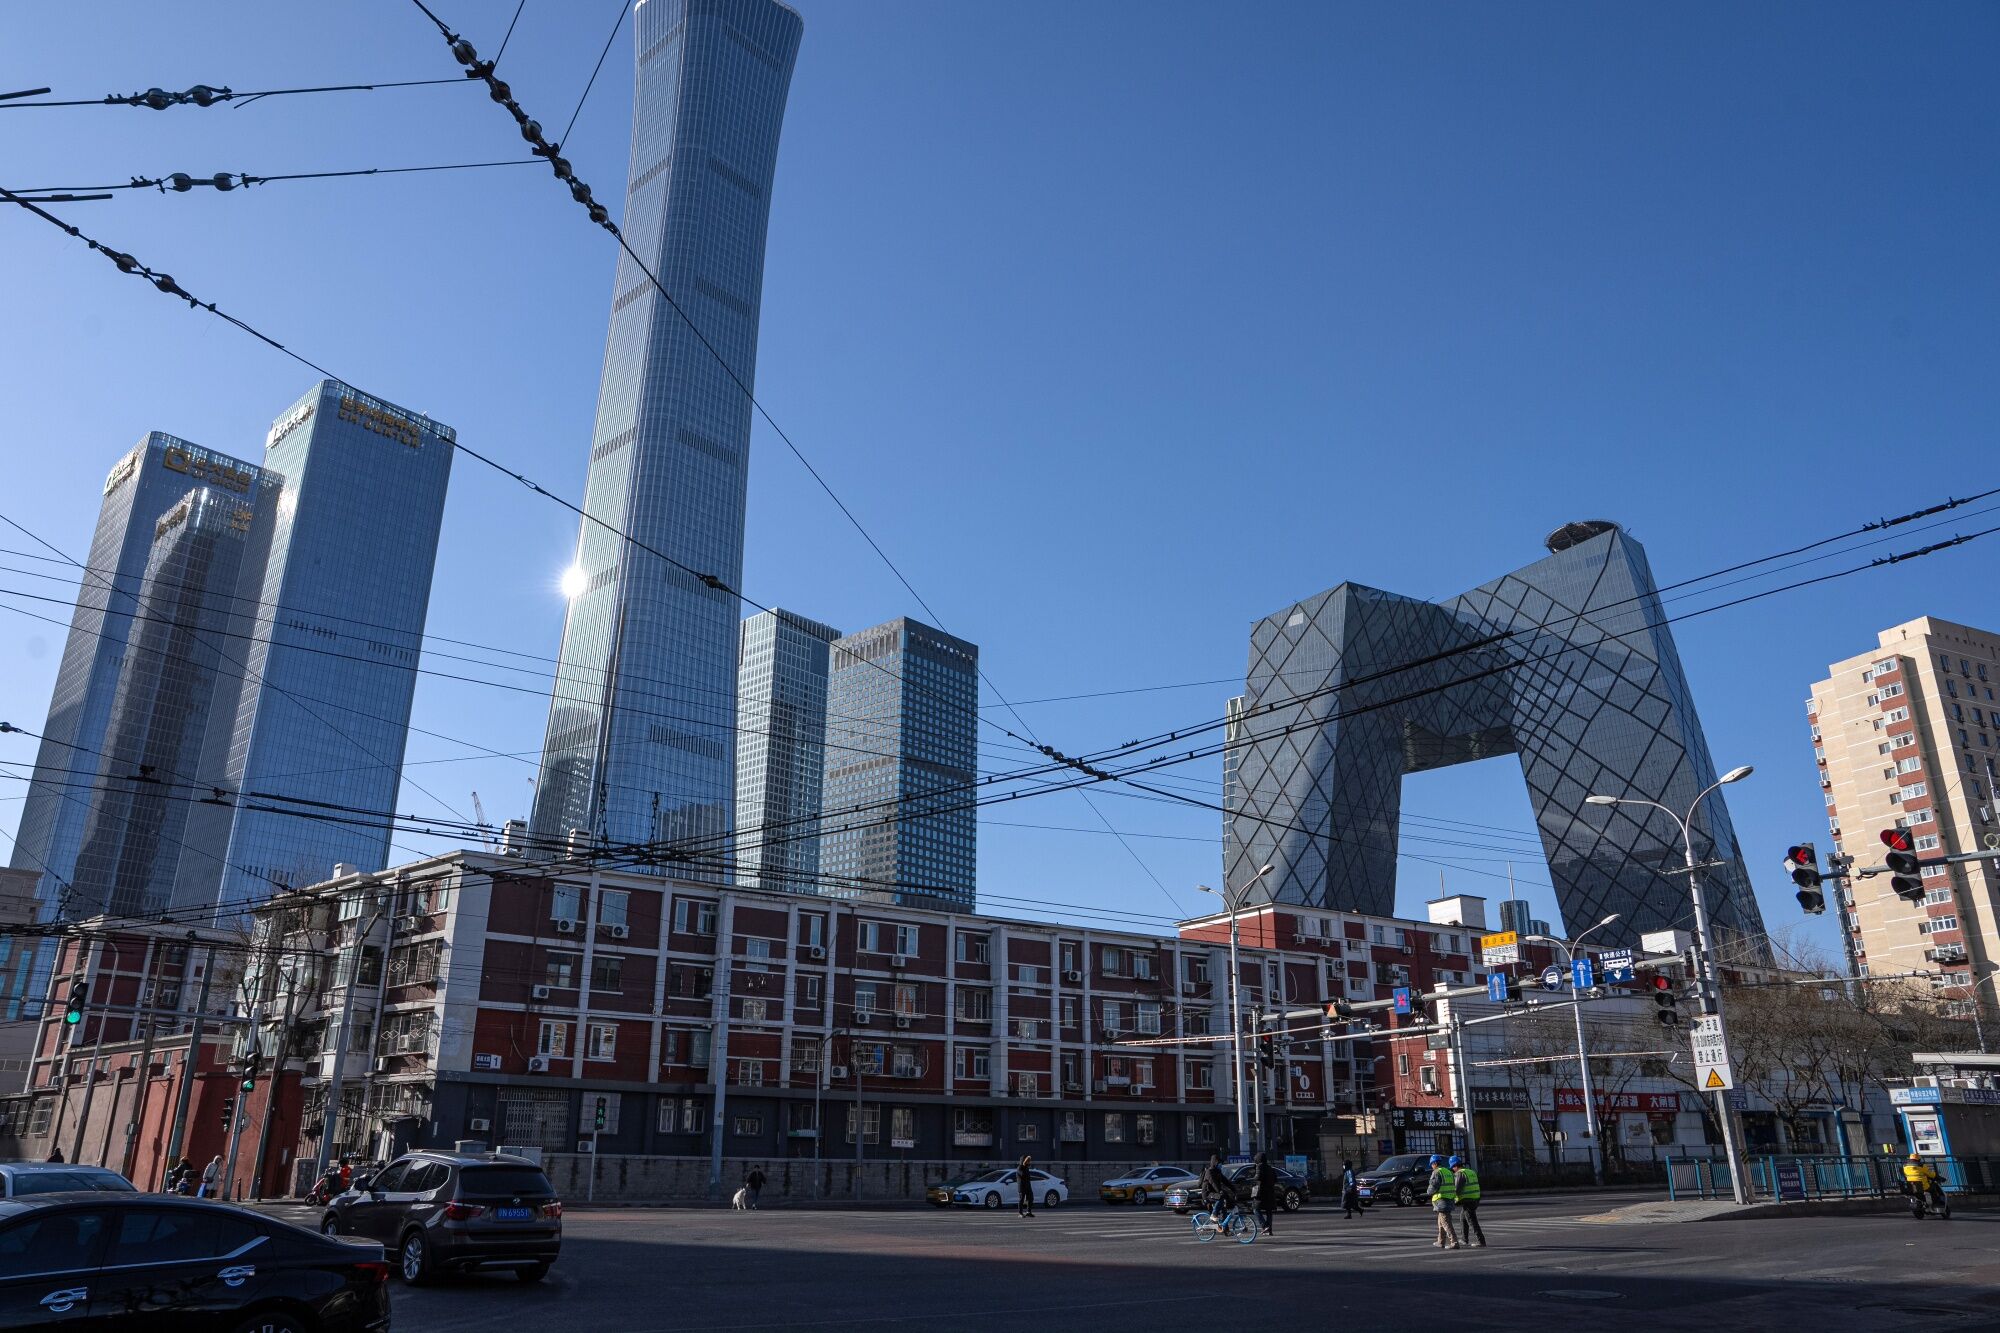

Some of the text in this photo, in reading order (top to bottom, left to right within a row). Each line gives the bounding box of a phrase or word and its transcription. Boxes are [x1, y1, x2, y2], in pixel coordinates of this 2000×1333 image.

[1603, 950, 1628, 960] 快速公交
[1698, 1049, 1723, 1064] 禁止通行
